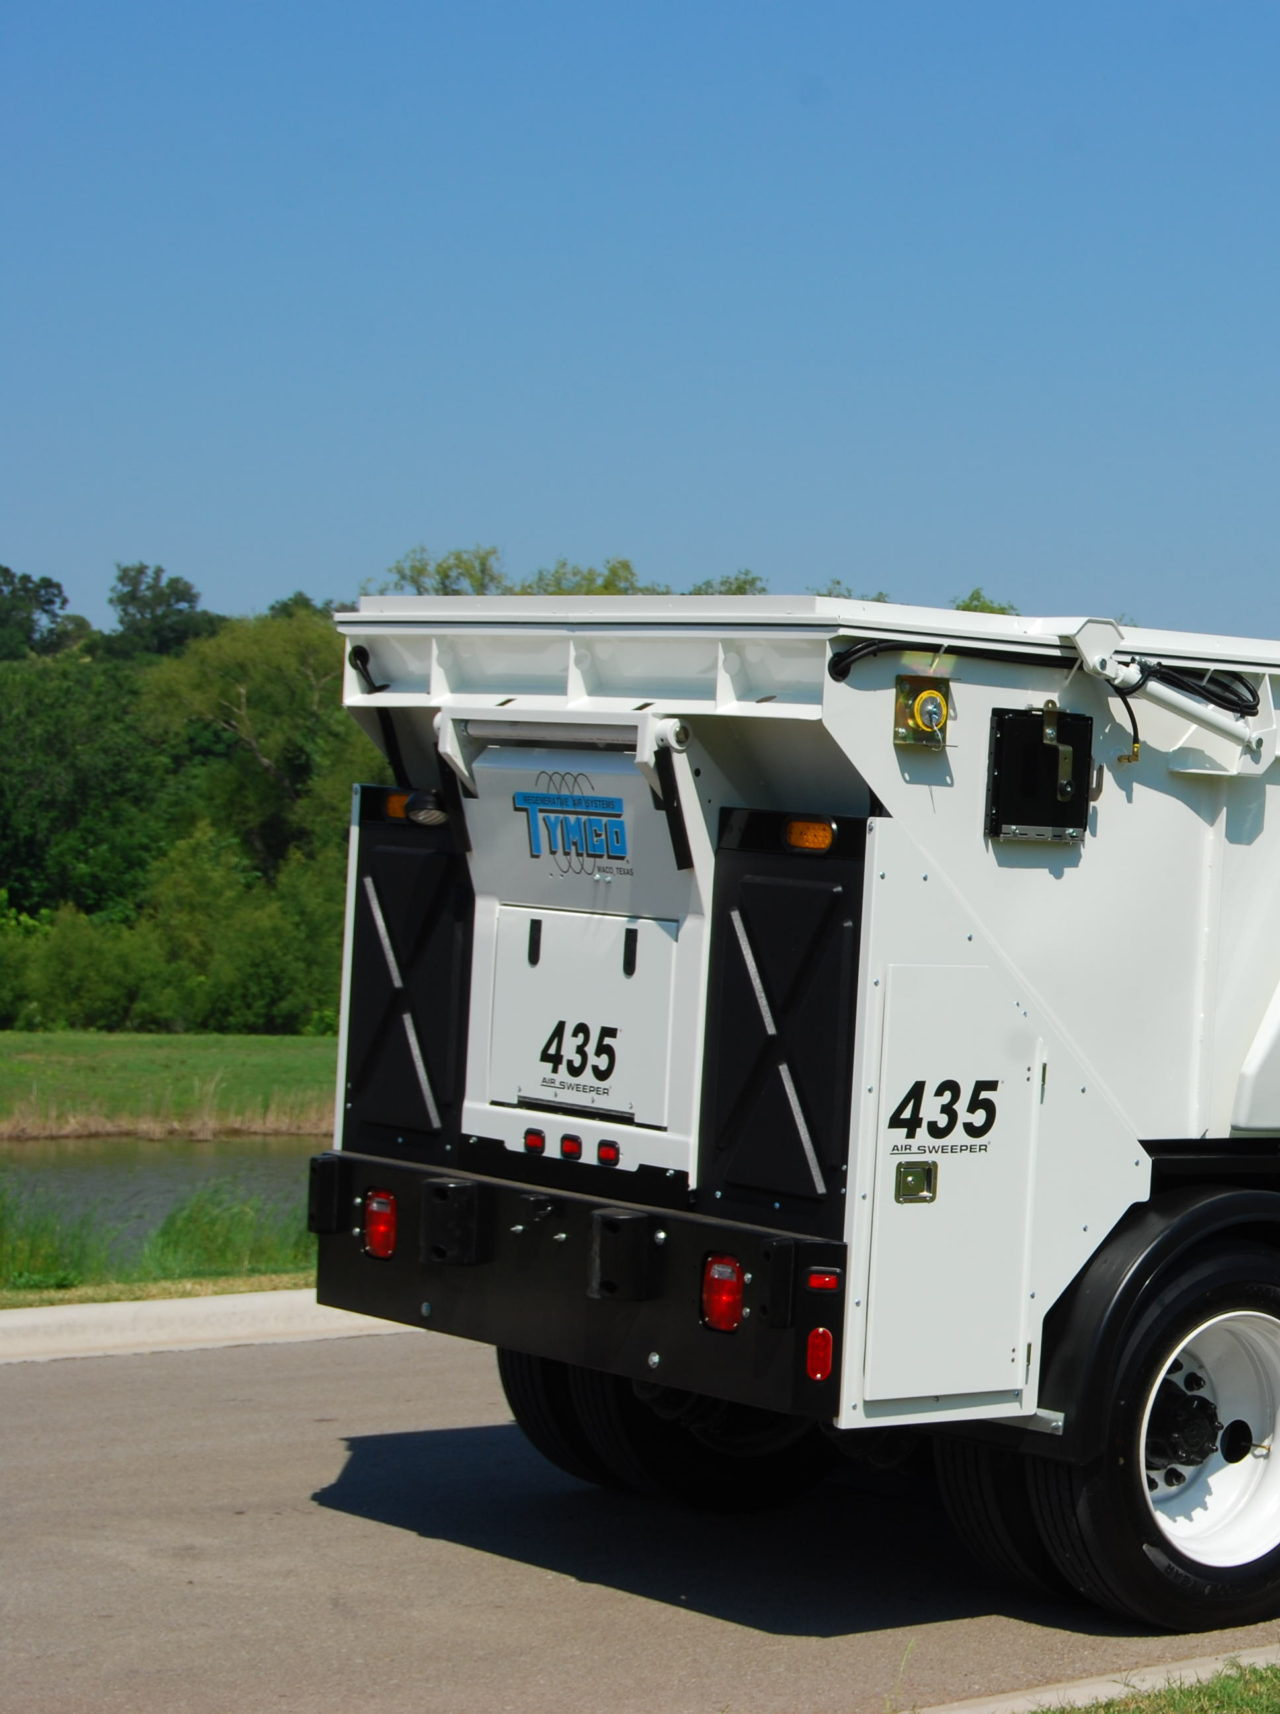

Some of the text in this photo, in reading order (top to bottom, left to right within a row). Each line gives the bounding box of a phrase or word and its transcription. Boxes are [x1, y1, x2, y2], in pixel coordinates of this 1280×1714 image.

[513, 792, 627, 860] TYMCO
[616, 867, 634, 876] TEXAS
[540, 1020, 618, 1082] 435
[541, 1077, 609, 1096] AIR SWEEPER
[887, 1079, 1000, 1140] 435
[891, 1144, 988, 1155] AIR SWEEPER
